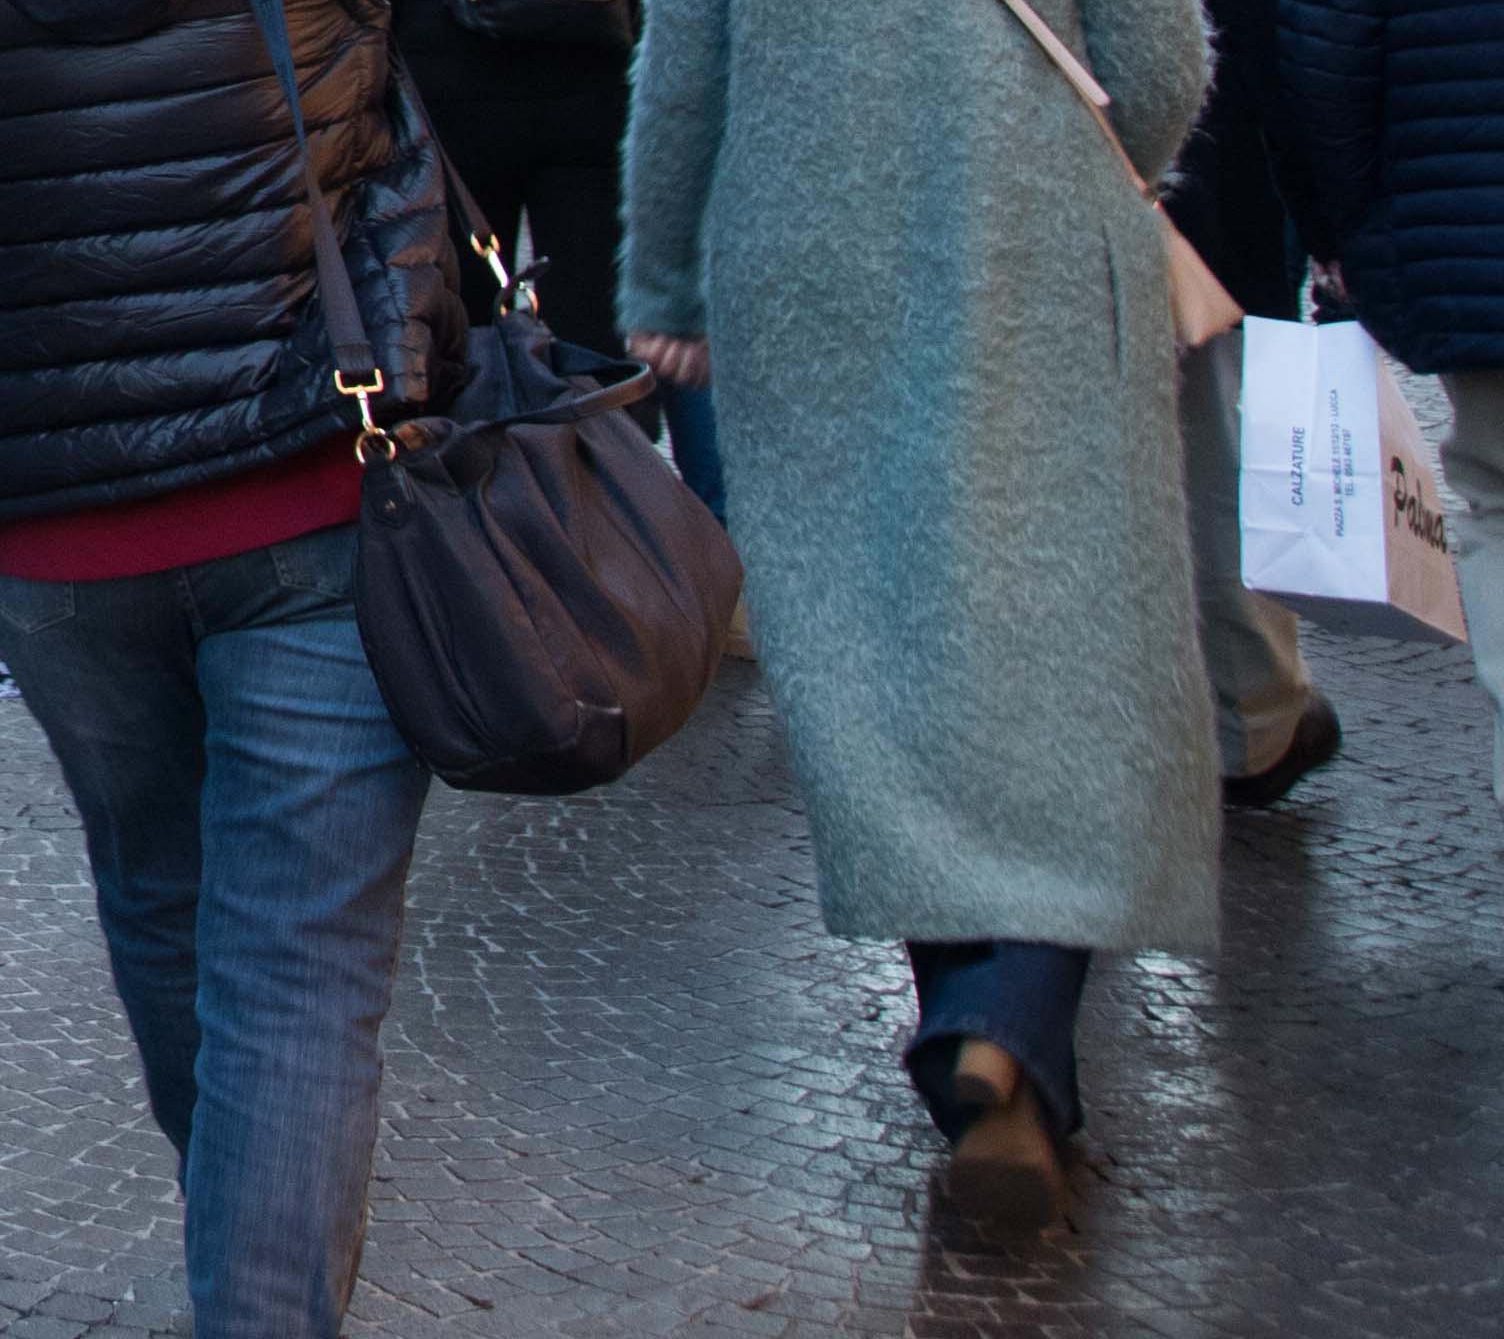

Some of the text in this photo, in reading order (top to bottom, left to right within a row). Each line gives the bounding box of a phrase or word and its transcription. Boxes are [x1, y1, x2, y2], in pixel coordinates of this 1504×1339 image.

[1329, 389, 1339, 417] LUCCA
[1290, 426, 1305, 507] CALZATURE
[1333, 506, 1345, 537] PIAZZA
